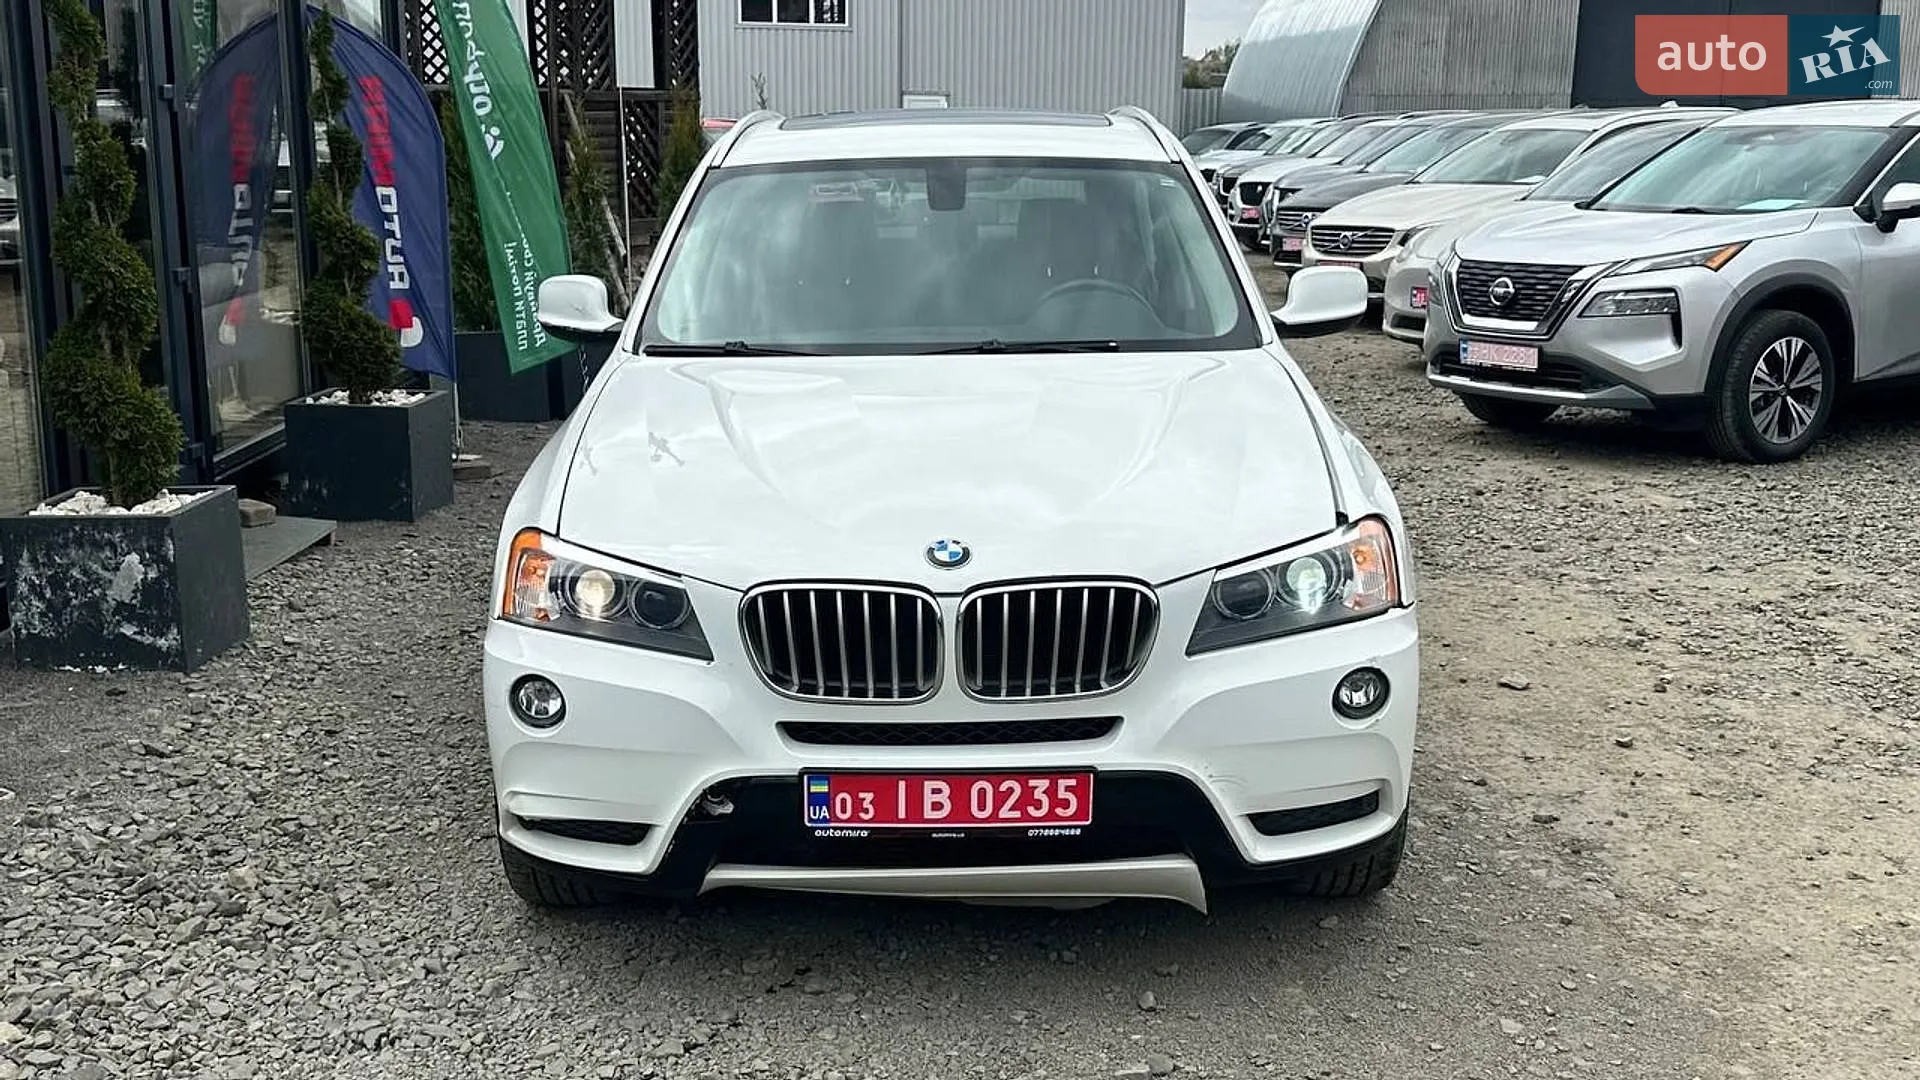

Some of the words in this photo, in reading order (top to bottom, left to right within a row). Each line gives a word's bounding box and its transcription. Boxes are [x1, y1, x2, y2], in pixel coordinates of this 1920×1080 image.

[809, 806, 830, 819] UA
[834, 791, 875, 820] 03
[969, 778, 1078, 819] 0235
